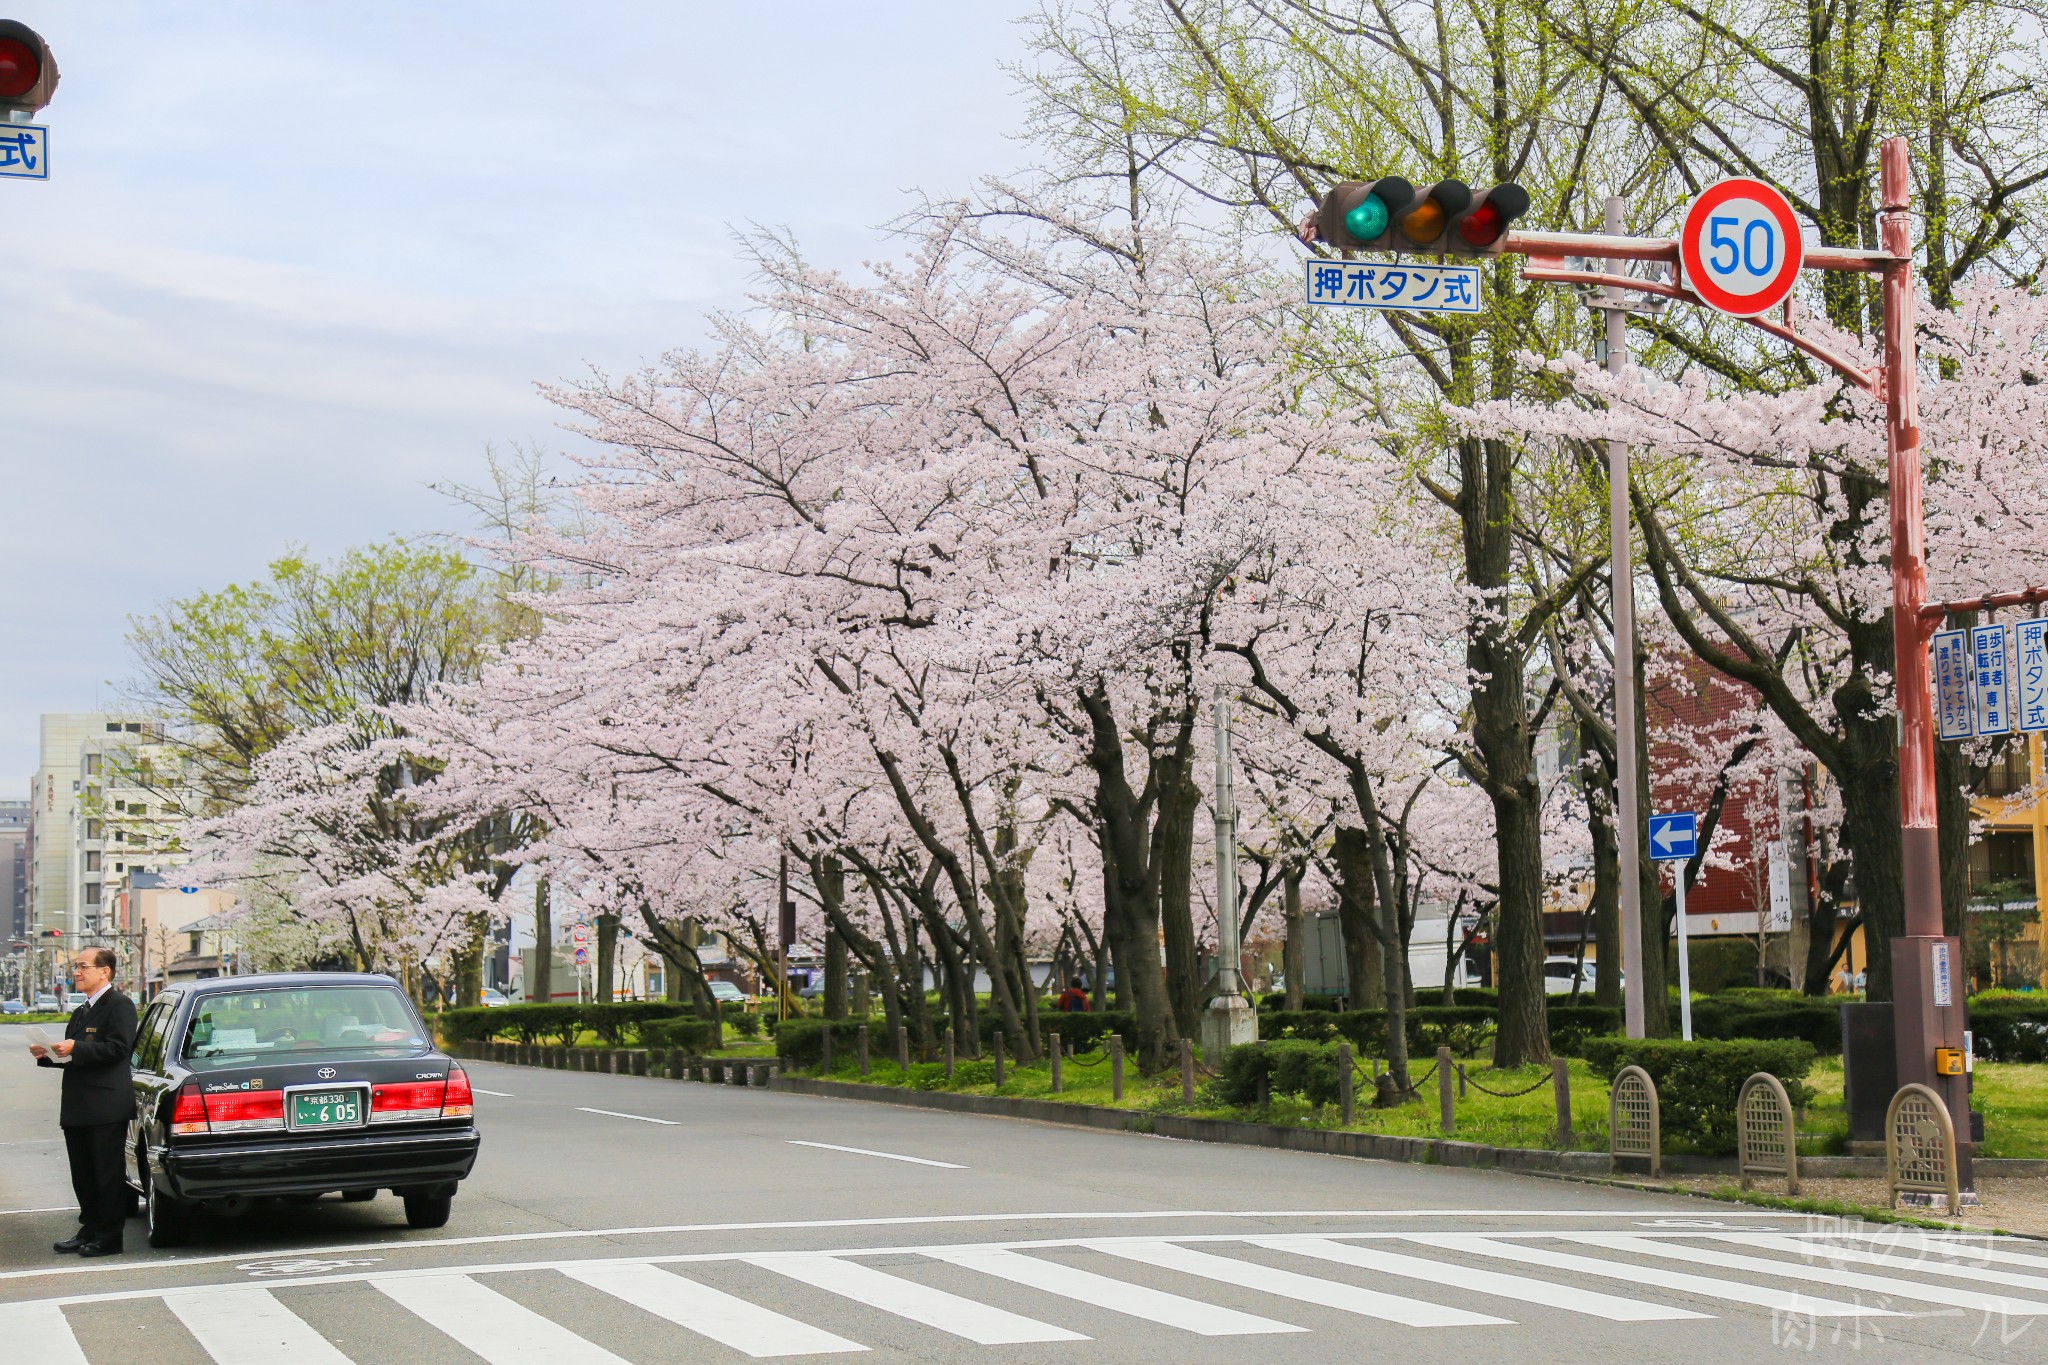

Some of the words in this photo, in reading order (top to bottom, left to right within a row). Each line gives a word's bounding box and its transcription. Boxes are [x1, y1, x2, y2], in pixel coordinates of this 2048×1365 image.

[1710, 217, 1774, 276] 50
[1315, 266, 1472, 305] 押ボタン式
[1939, 647, 1954, 726] 渡りましょう
[1951, 638, 1967, 731] 青になってから
[1977, 634, 1990, 687] 自転車
[1990, 632, 2003, 686] 歩行者
[2024, 626, 2045, 725] 押ボタン式
[1986, 691, 1999, 728] 専用
